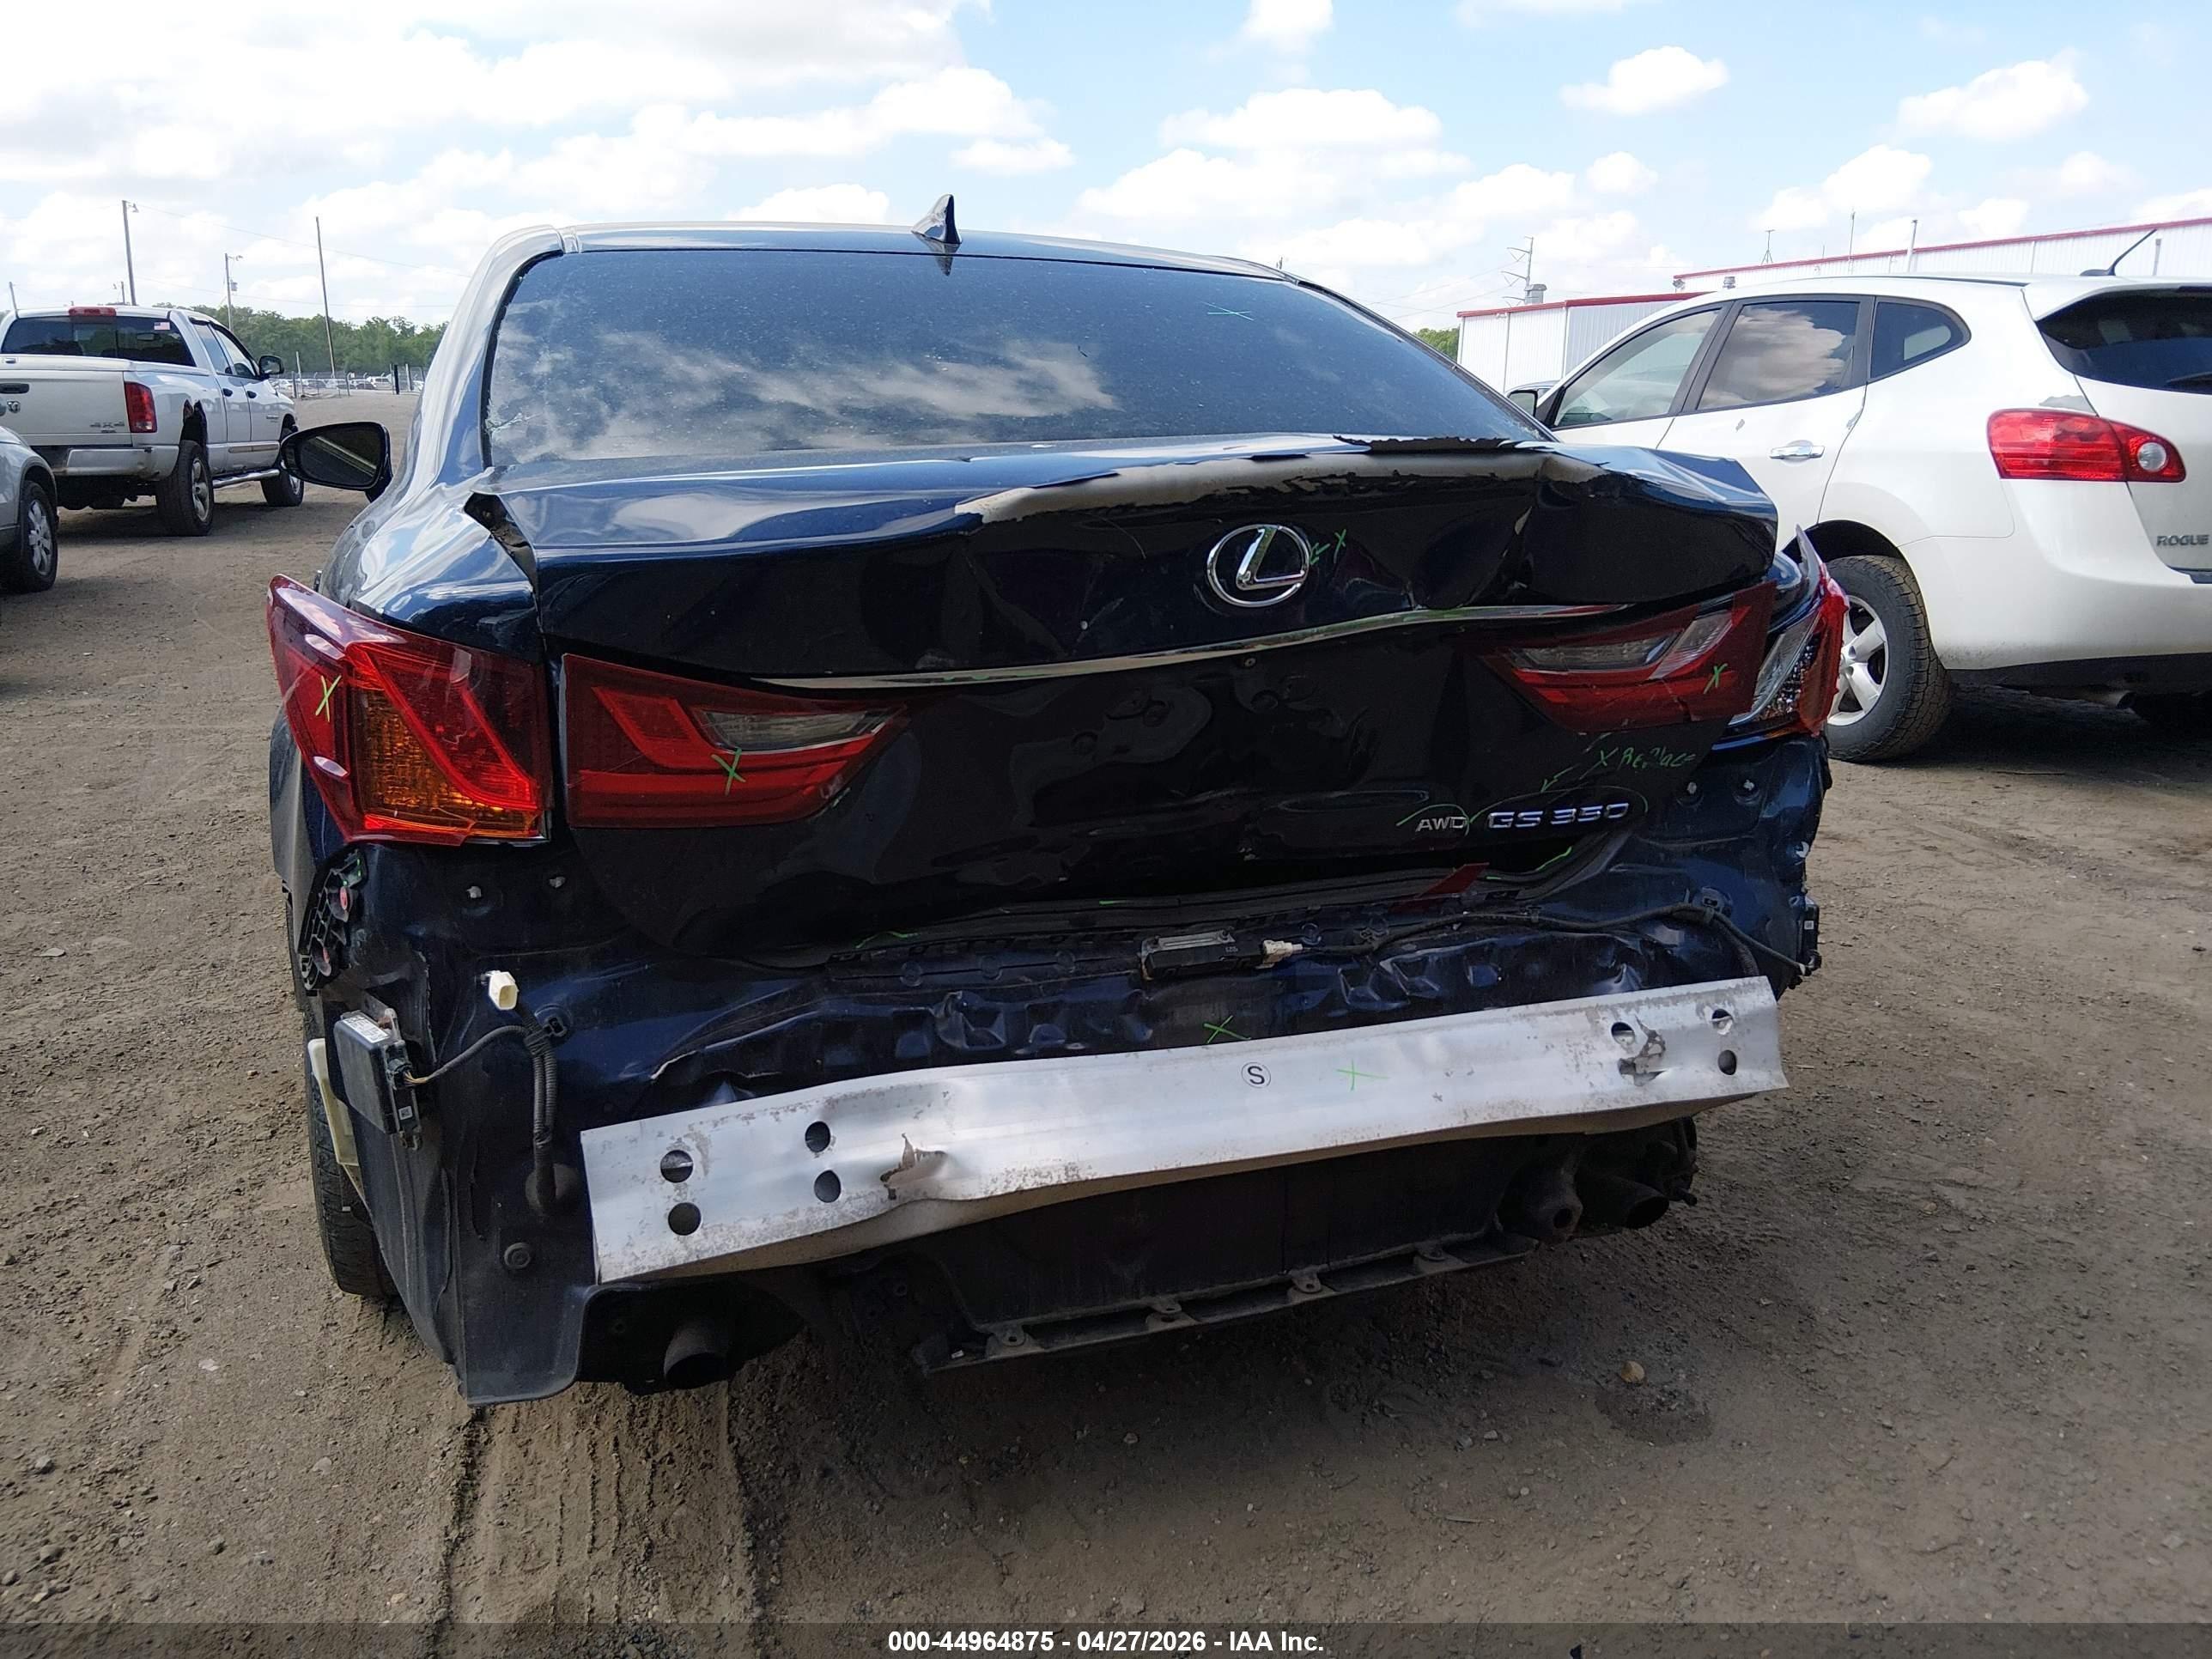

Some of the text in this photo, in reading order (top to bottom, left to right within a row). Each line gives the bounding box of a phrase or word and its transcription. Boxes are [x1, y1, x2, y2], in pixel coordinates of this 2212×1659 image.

[2156, 534, 2210, 547] ROGUE
[1415, 802, 1630, 832] AWD GS 350
